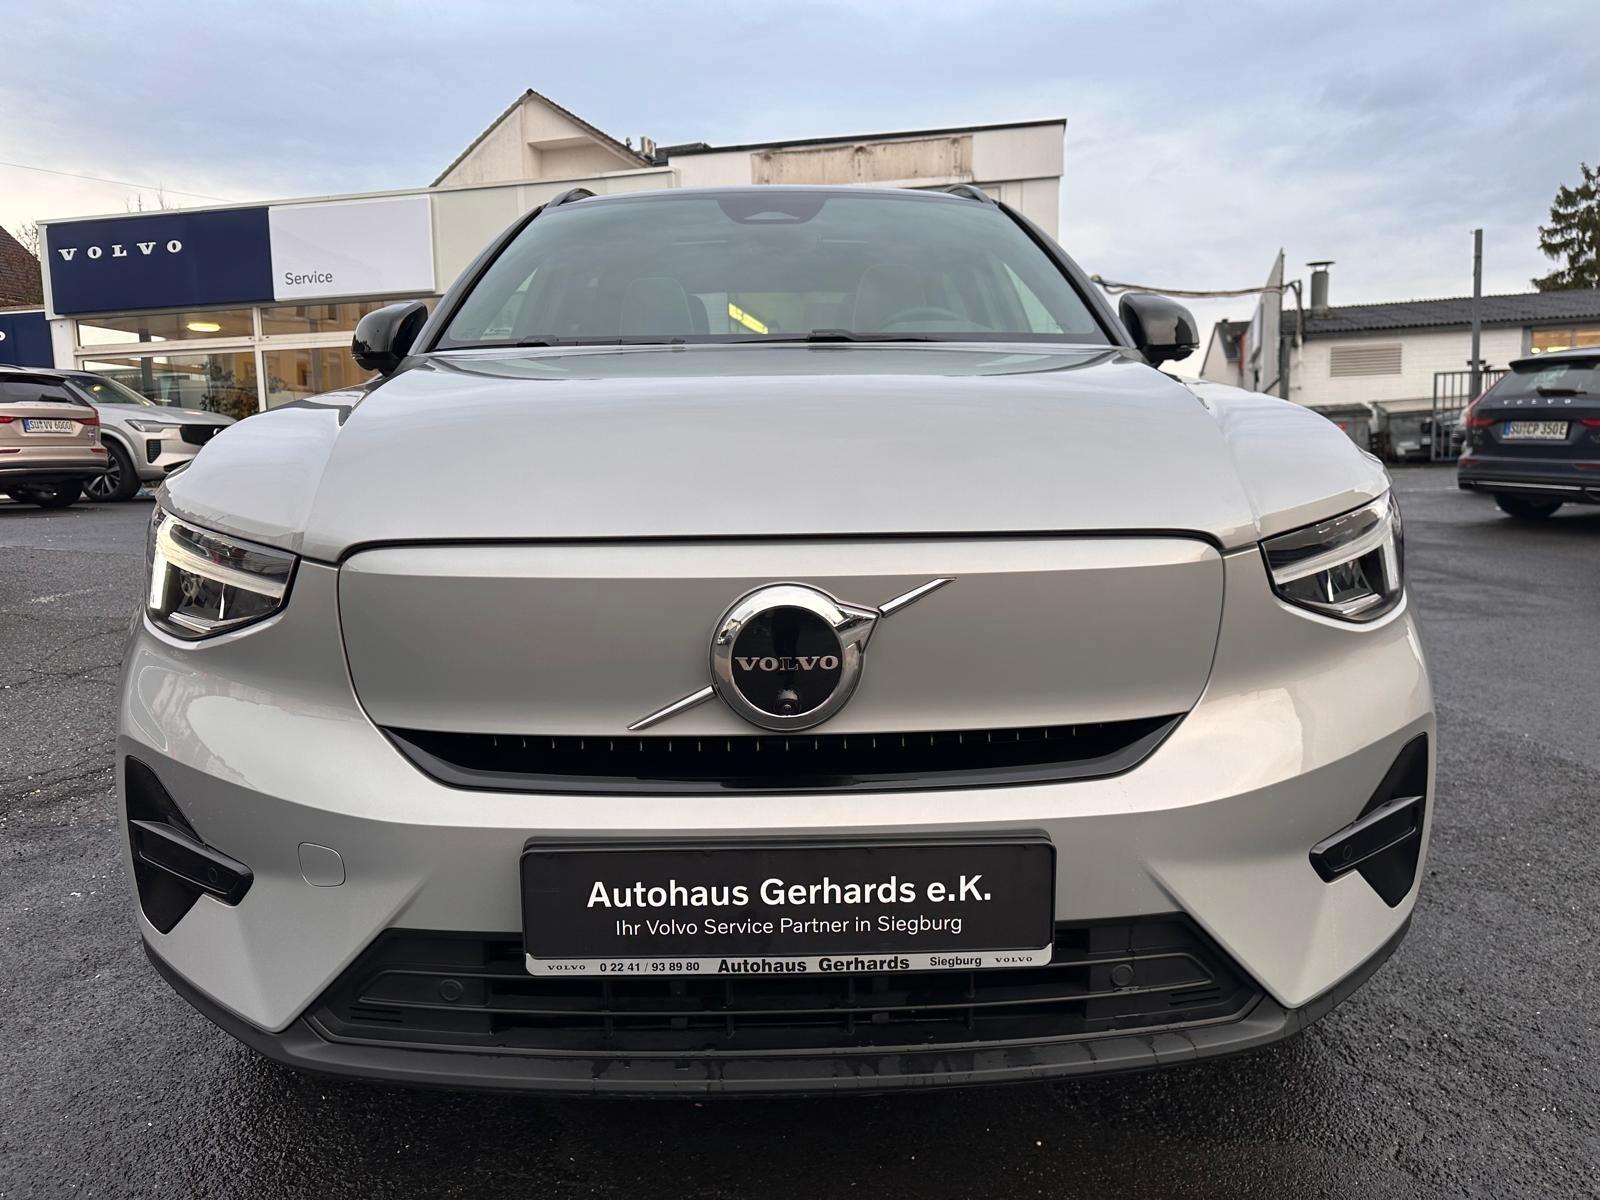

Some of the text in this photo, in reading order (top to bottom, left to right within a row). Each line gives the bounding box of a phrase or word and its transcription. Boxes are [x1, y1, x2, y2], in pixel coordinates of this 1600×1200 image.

[58, 240, 183, 261] VOLVO
[285, 270, 333, 285] Service
[735, 656, 838, 671] VOLVO
[587, 875, 991, 907] Autohaus Gerhards e.K.
[617, 915, 961, 935] Ihr Volvo Service Partner in Siegburg
[599, 963, 607, 973] 0
[611, 963, 624, 972] 22
[627, 963, 640, 972] 41
[652, 962, 666, 972] 93
[668, 962, 683, 972] 89
[685, 961, 700, 971] 80
[718, 959, 807, 974] Autohaus
[818, 956, 910, 971] Gerhards
[929, 957, 982, 970] Siegburg
